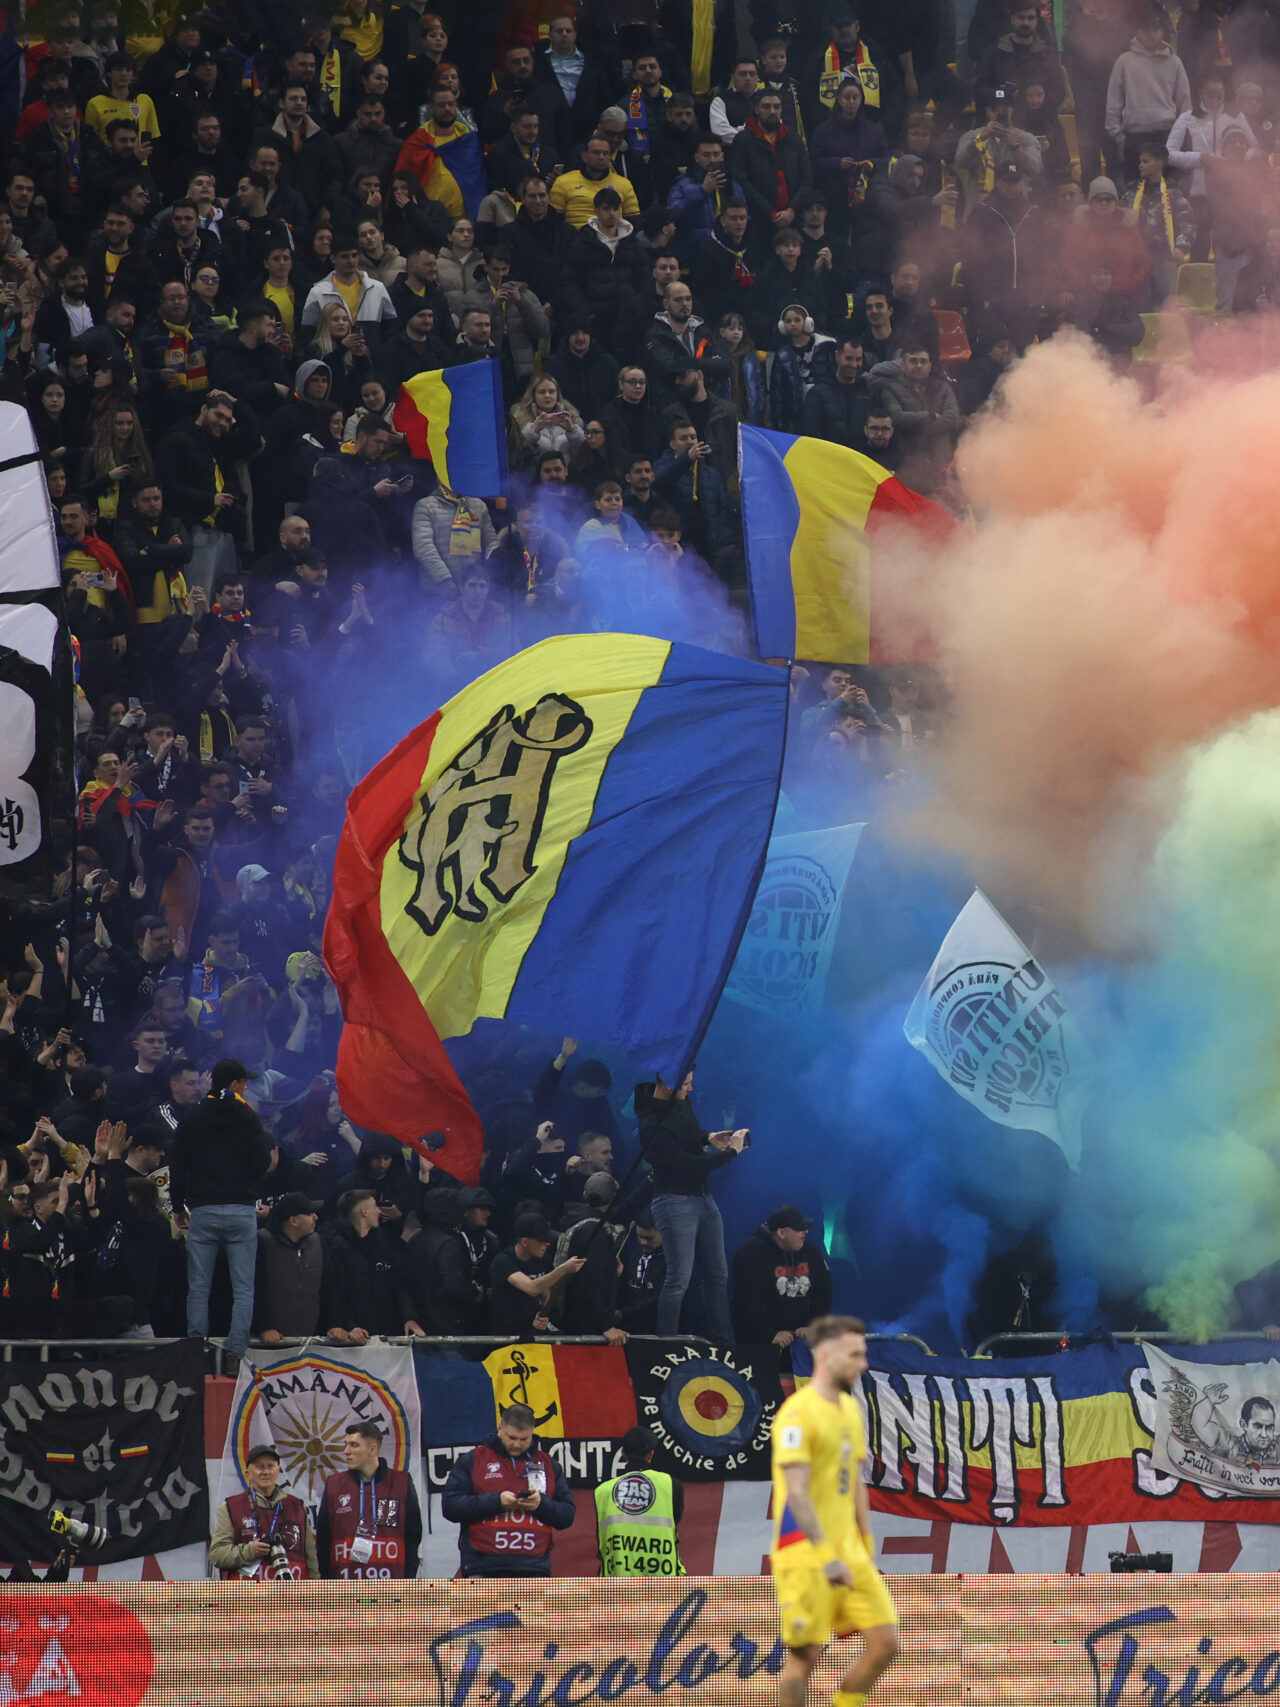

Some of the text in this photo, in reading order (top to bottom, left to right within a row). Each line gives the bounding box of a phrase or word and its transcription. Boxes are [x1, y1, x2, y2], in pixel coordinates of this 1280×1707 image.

[650, 1346, 753, 1381] BRAILA
[640, 1395, 659, 1415] pe
[650, 1421, 715, 1470] muchie
[726, 1452, 748, 1469] de
[617, 1481, 650, 1498] SAS
[617, 1496, 649, 1507] TEAM
[334, 1541, 399, 1561] PHTO
[495, 1531, 536, 1551] 525
